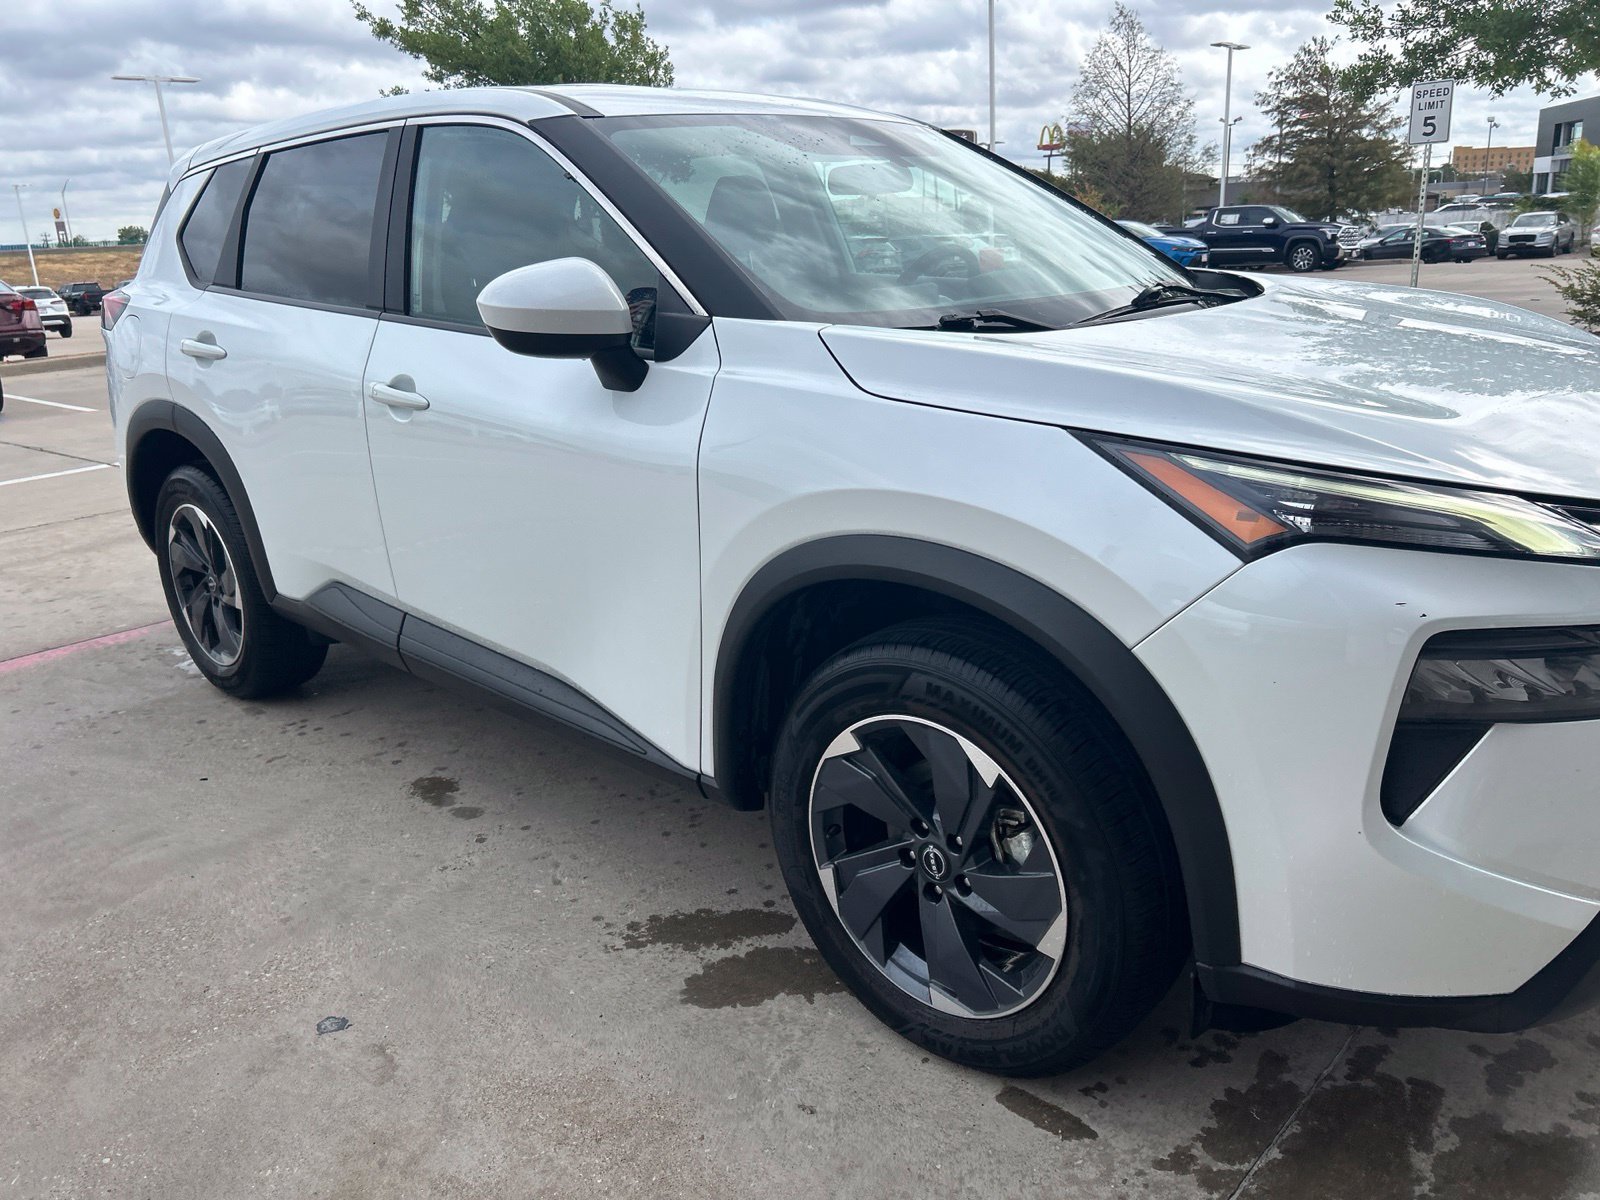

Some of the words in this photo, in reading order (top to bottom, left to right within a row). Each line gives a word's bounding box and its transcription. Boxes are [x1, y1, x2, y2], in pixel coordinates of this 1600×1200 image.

[1416, 87, 1450, 99] SPEED
[1418, 100, 1446, 111] LIMIT
[1422, 115, 1437, 137] 5
